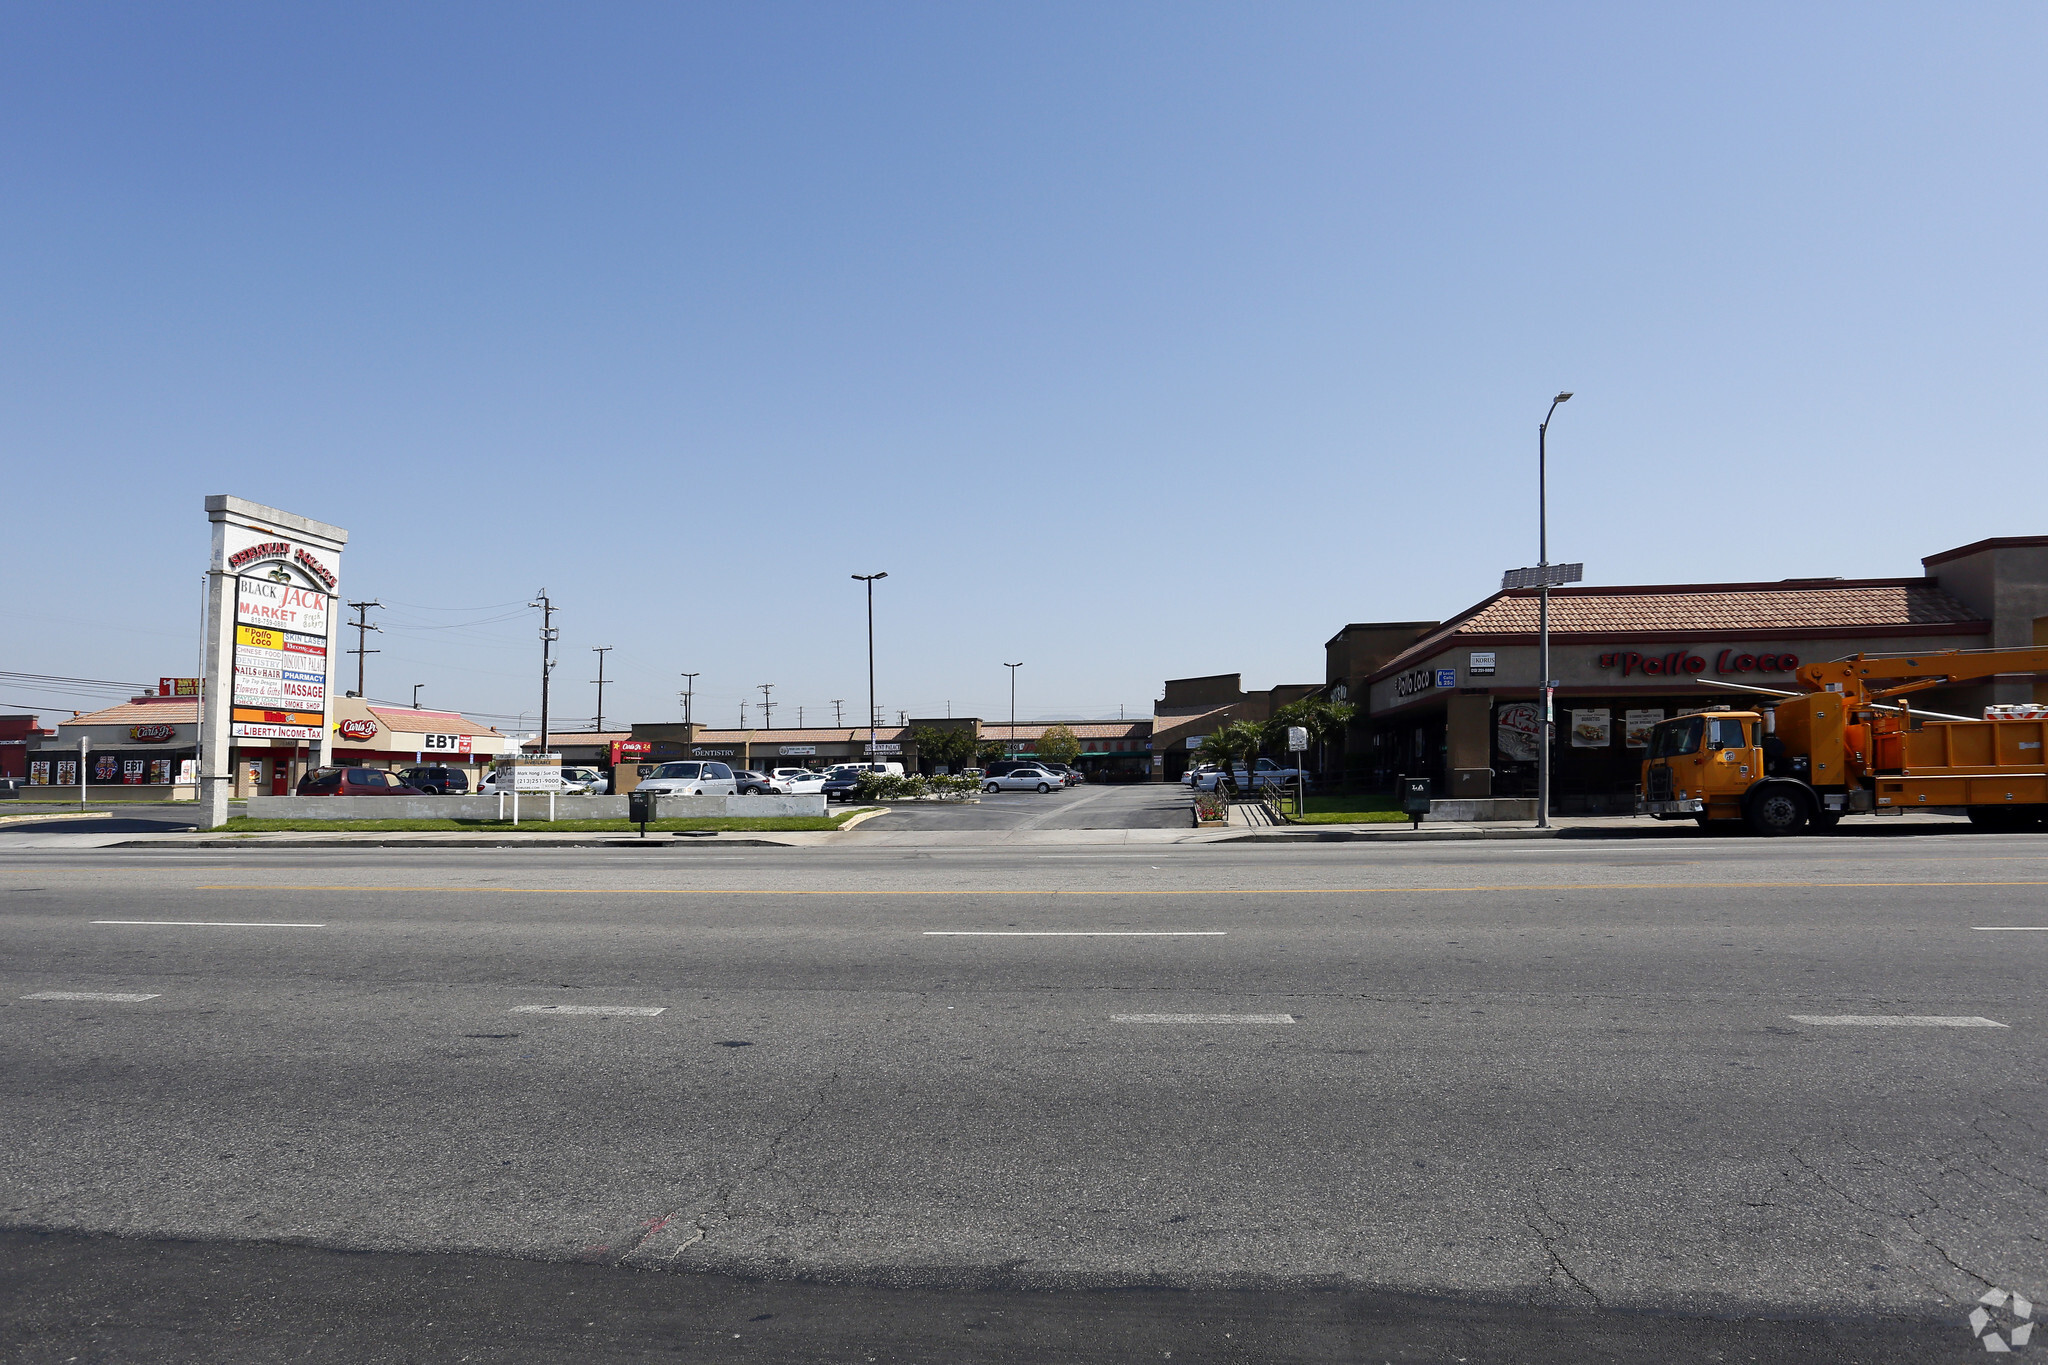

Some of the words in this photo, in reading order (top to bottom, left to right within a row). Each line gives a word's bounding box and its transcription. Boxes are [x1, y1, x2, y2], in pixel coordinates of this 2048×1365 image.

[229, 542, 291, 567] SHERMAN
[295, 548, 338, 588] SQUARE
[241, 580, 277, 599] BLACK
[278, 587, 326, 611] JACK
[240, 602, 297, 622] MARKET
[303, 612, 321, 620] Fresh
[251, 629, 272, 639] Pollo
[285, 633, 302, 642] SKIN
[304, 636, 326, 646] LASER
[251, 637, 271, 646] Loco
[236, 646, 262, 655] CHINESE
[264, 650, 281, 658] FOOD
[236, 657, 280, 668] DENTISTRY
[284, 654, 306, 670] DISCOUNT
[1600, 653, 1619, 668] El
[1624, 650, 1706, 677] Pollo
[1716, 649, 1799, 674] Loco
[235, 666, 257, 675] NAILS
[262, 670, 280, 678] HAIR
[284, 671, 324, 682] PHARMACY
[1414, 671, 1430, 692] Loco
[235, 683, 259, 694] Flowers
[284, 683, 323, 698] MASSAGE
[244, 725, 277, 737] LIBERTY
[278, 726, 306, 737] INCOME
[307, 729, 321, 738] TAX
[344, 721, 365, 732] Carl's
[425, 735, 458, 749] EBT
[126, 761, 142, 771] EBT
[96, 768, 113, 779] 24
